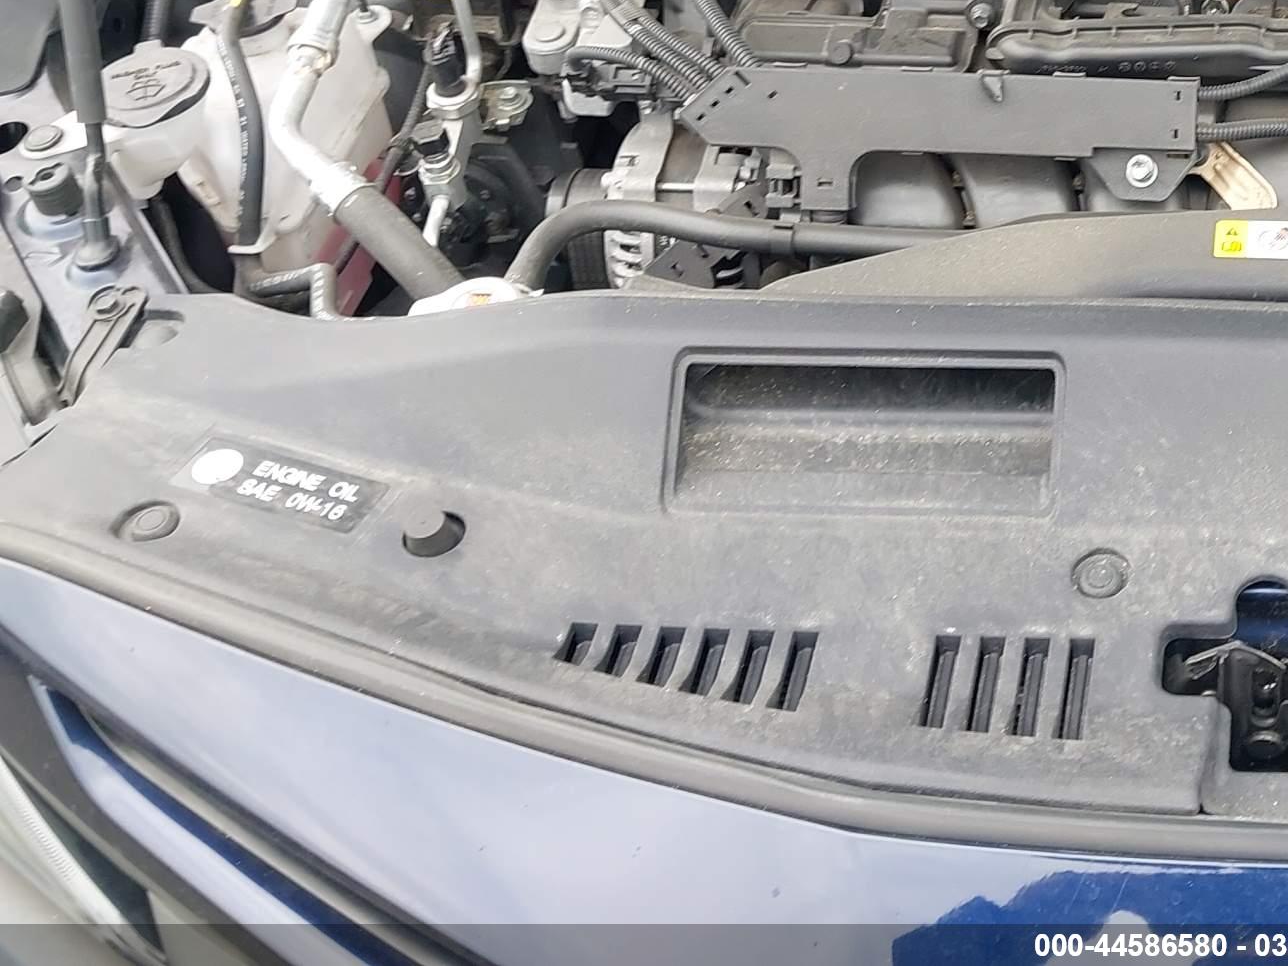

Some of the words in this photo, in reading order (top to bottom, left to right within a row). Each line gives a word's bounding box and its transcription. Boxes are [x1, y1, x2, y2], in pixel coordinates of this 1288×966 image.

[236, 478, 283, 502] SAE
[253, 460, 327, 491] ENGINE
[328, 481, 361, 503] OIL
